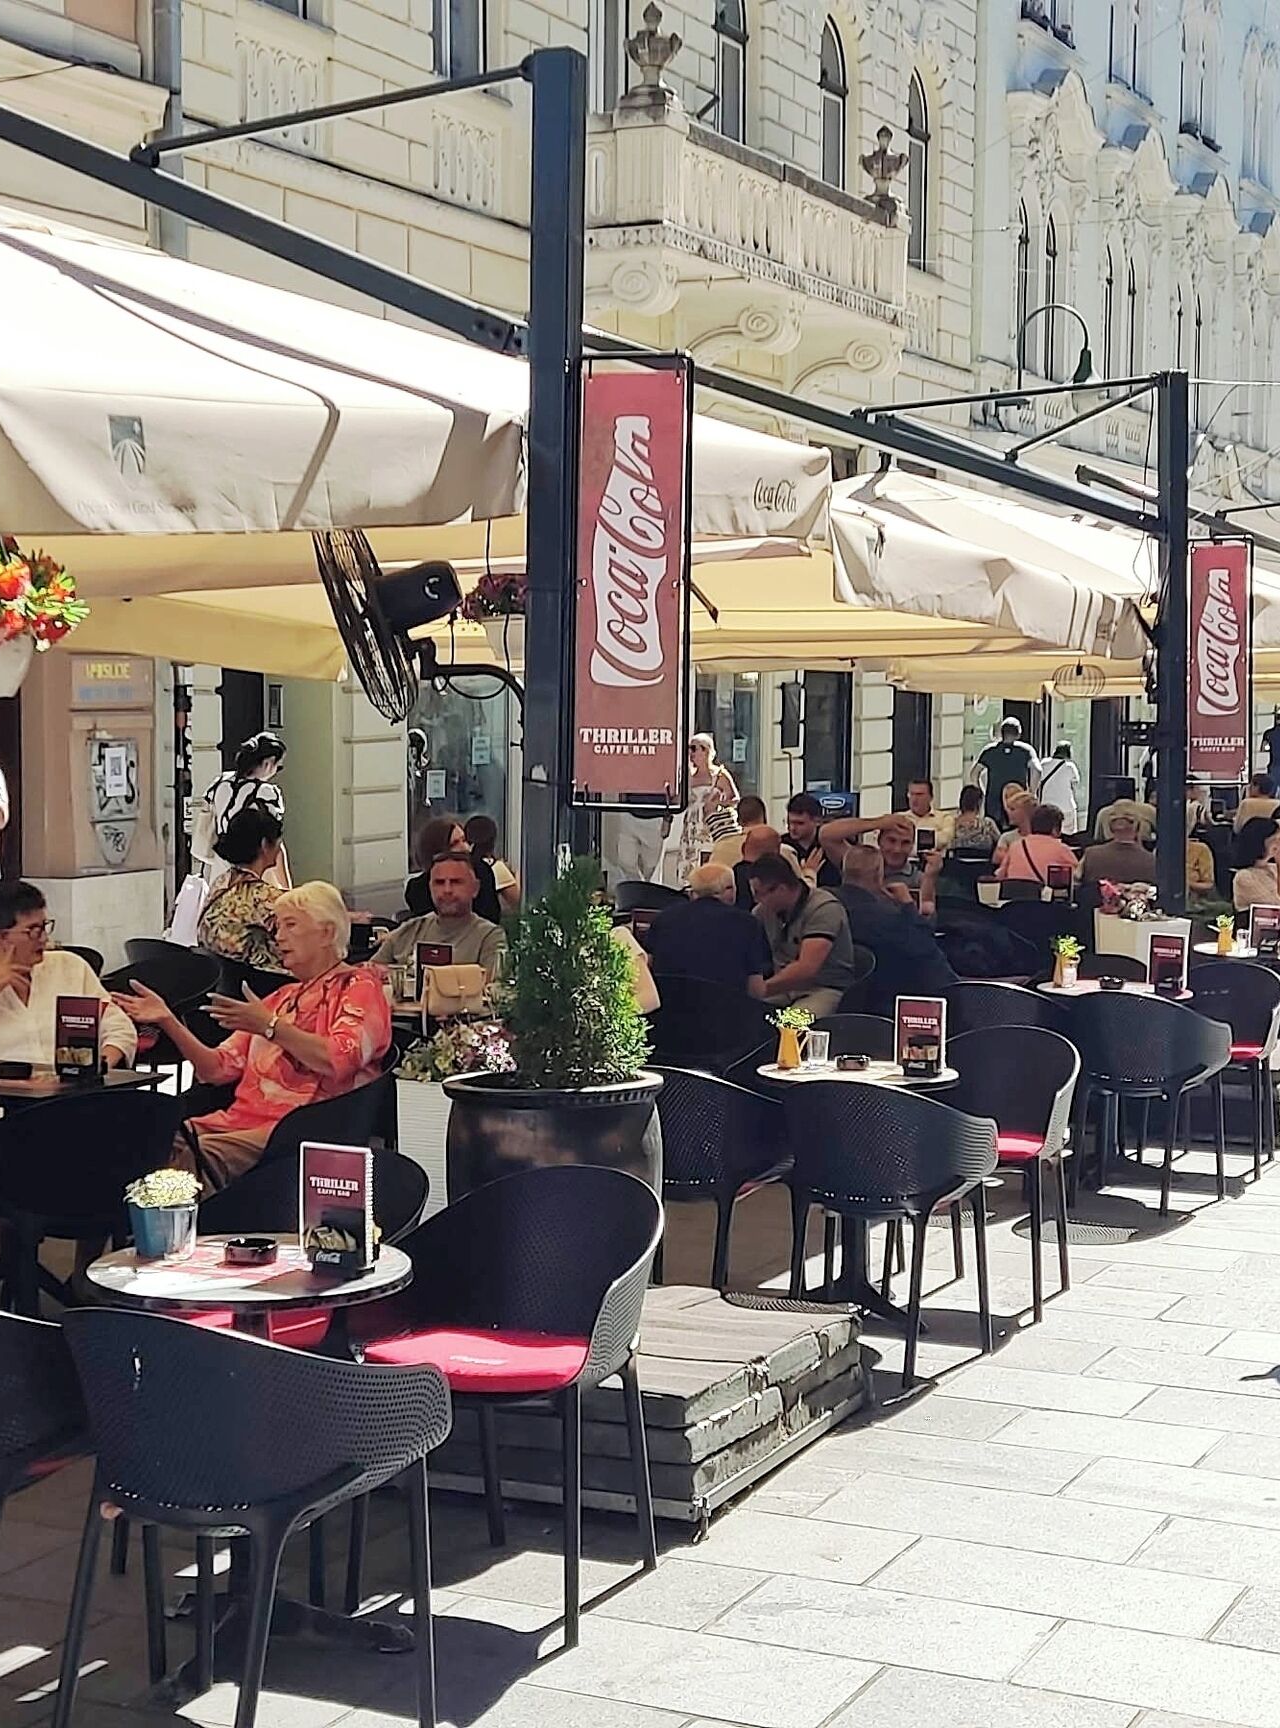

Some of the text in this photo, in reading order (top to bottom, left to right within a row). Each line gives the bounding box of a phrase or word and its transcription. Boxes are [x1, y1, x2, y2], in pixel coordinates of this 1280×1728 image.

[579, 728, 673, 745] THRILLER
[1191, 737, 1244, 746] THRILLER
[593, 745, 656, 755] CAFFE BAR
[309, 1176, 359, 1192] THRILLER
